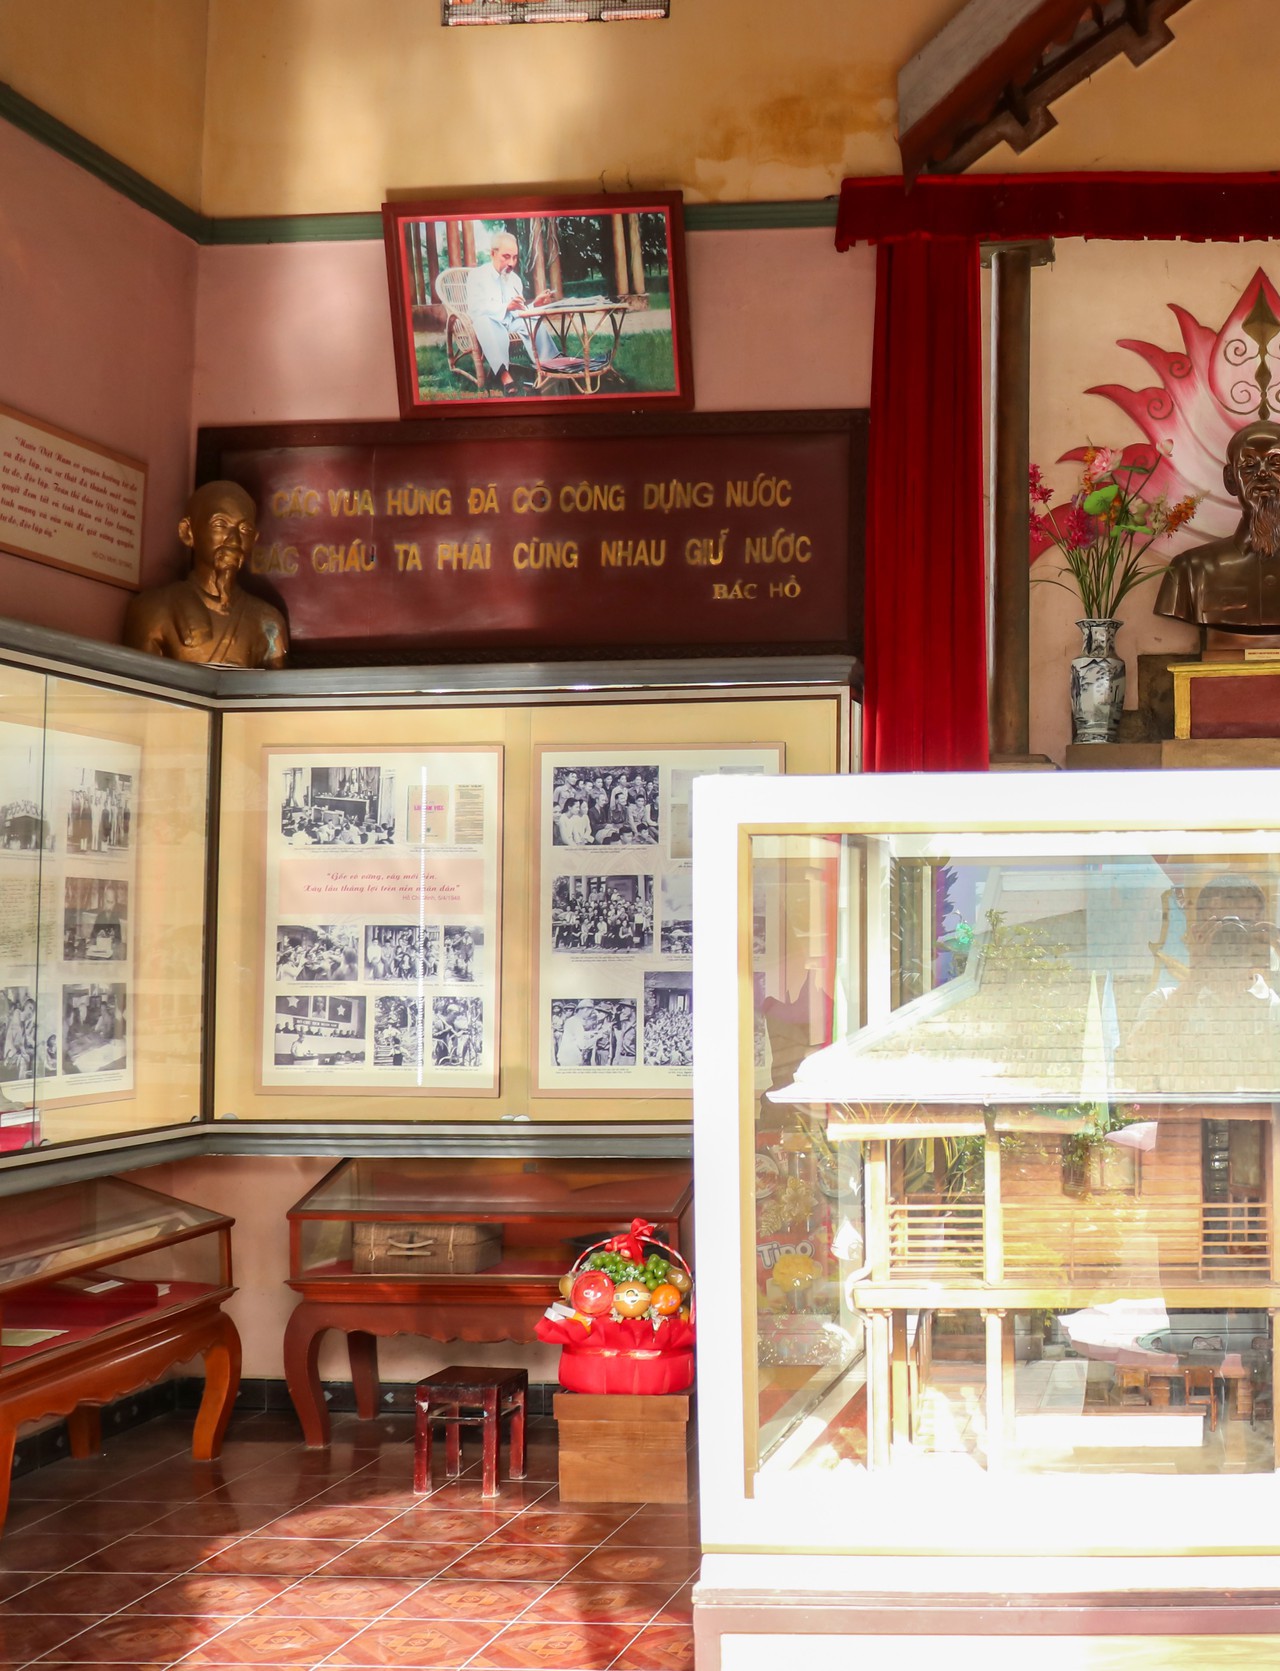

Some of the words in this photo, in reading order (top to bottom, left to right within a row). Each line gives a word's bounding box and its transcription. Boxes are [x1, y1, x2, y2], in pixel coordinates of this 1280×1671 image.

[328, 487, 375, 517] VUA
[386, 483, 452, 517] HÙNG
[467, 483, 500, 515] ĐÃ
[512, 480, 552, 514] CÓ
[559, 481, 625, 513] CÔNG
[643, 479, 714, 514] DỰNG
[726, 473, 792, 508] NƯỚC
[311, 538, 376, 574] CHÁU
[394, 543, 422, 571] TA
[437, 536, 491, 571] PHẢI
[513, 536, 579, 570] CÙNG
[601, 539, 667, 568] NHAU
[685, 528, 730, 566] GIỮ
[745, 527, 812, 564] NƯỚC
[712, 579, 757, 600] BÁC
[769, 574, 801, 599] HỒ
